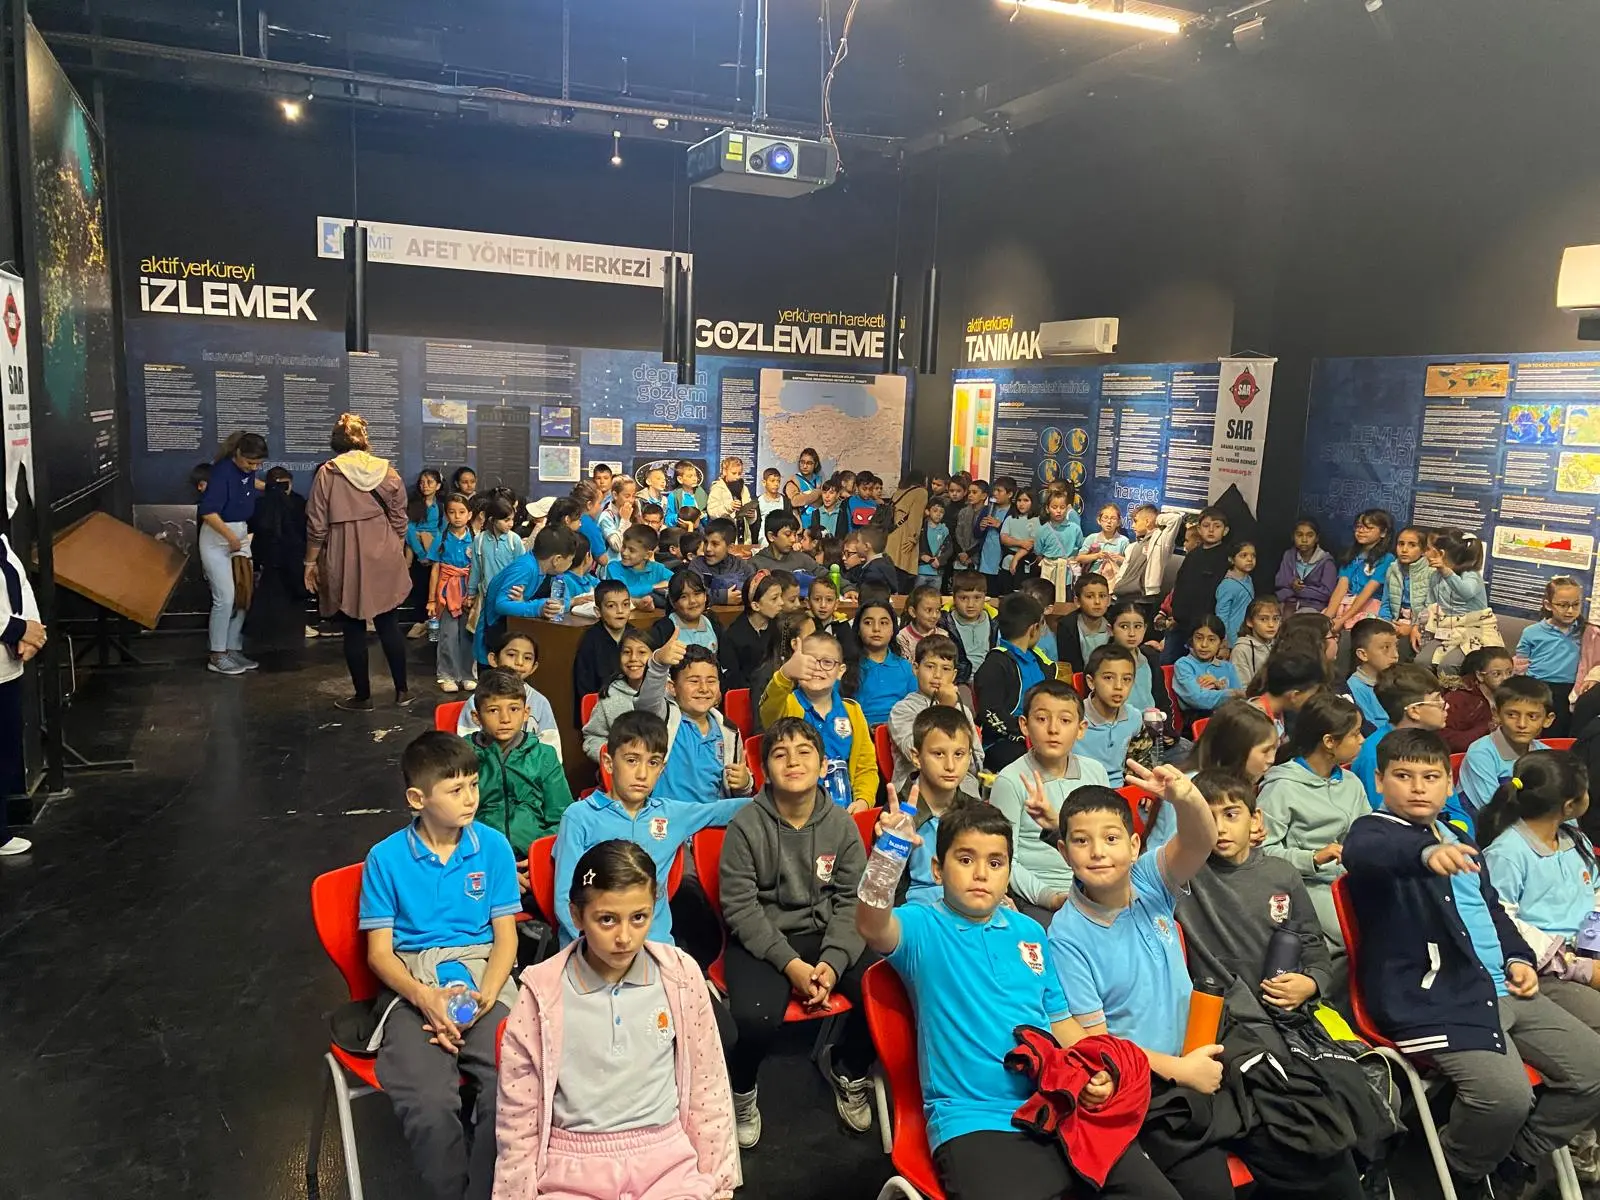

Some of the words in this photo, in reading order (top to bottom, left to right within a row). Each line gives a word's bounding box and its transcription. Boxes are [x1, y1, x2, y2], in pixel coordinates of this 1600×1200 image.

[140, 256, 179, 275] aktif
[180, 259, 256, 282] yerküreyi
[406, 238, 462, 260] AFET
[467, 240, 560, 269] YÖNETİM
[566, 252, 651, 278] MERKEZİ
[778, 308, 838, 325] yerkürenin
[966, 317, 982, 333] aktif
[965, 330, 1043, 362] TANIMAK
[8, 364, 25, 395] SAR
[632, 363, 708, 385] deprm
[637, 381, 708, 403] gözlem
[653, 399, 707, 421] ağları
[1226, 419, 1253, 440] SAR
[1350, 424, 1416, 448] LEVHA
[1114, 481, 1160, 503] hareket
